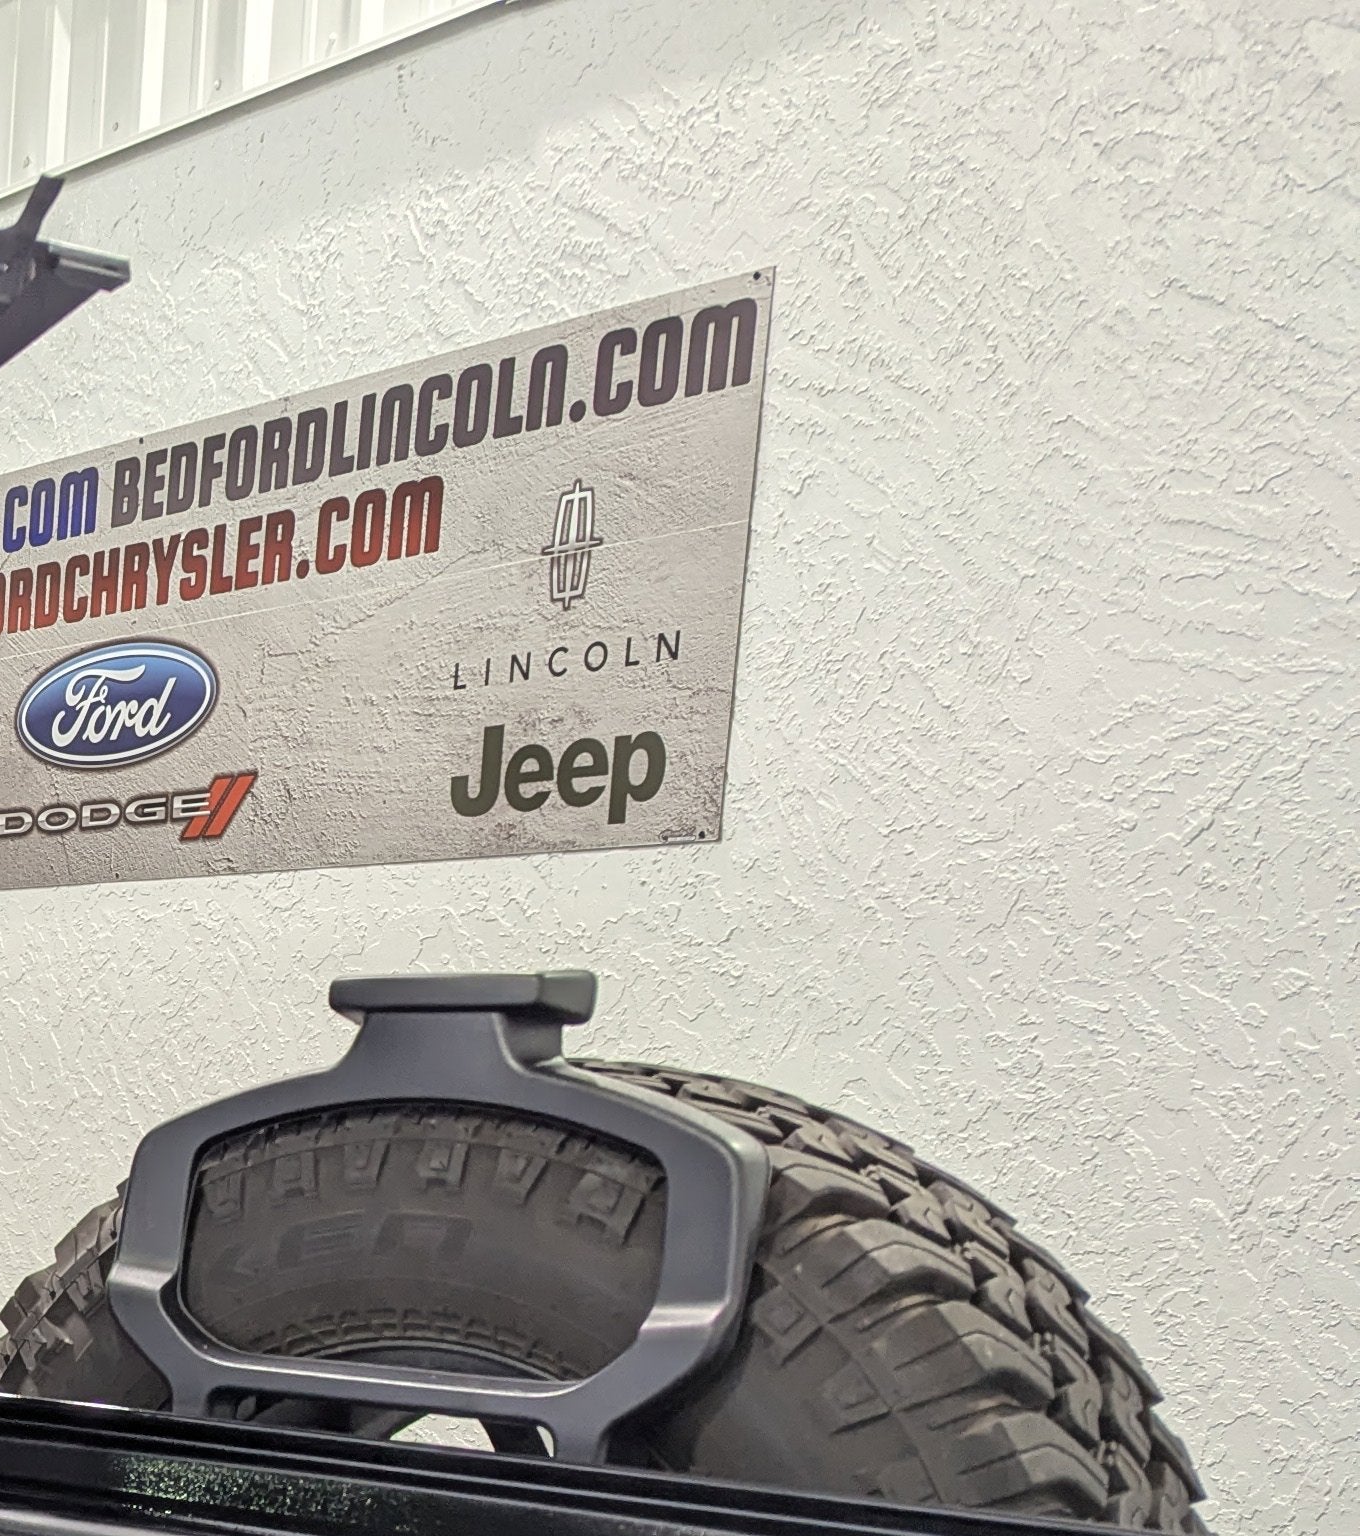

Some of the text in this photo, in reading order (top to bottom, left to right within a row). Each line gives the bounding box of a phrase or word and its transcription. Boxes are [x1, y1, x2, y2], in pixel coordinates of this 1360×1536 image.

[110, 298, 758, 529] BEDFORDLINCOLN.COM
[51, 664, 177, 747] Ford
[453, 629, 680, 690] LINCOLN
[450, 723, 666, 825] Jeep
